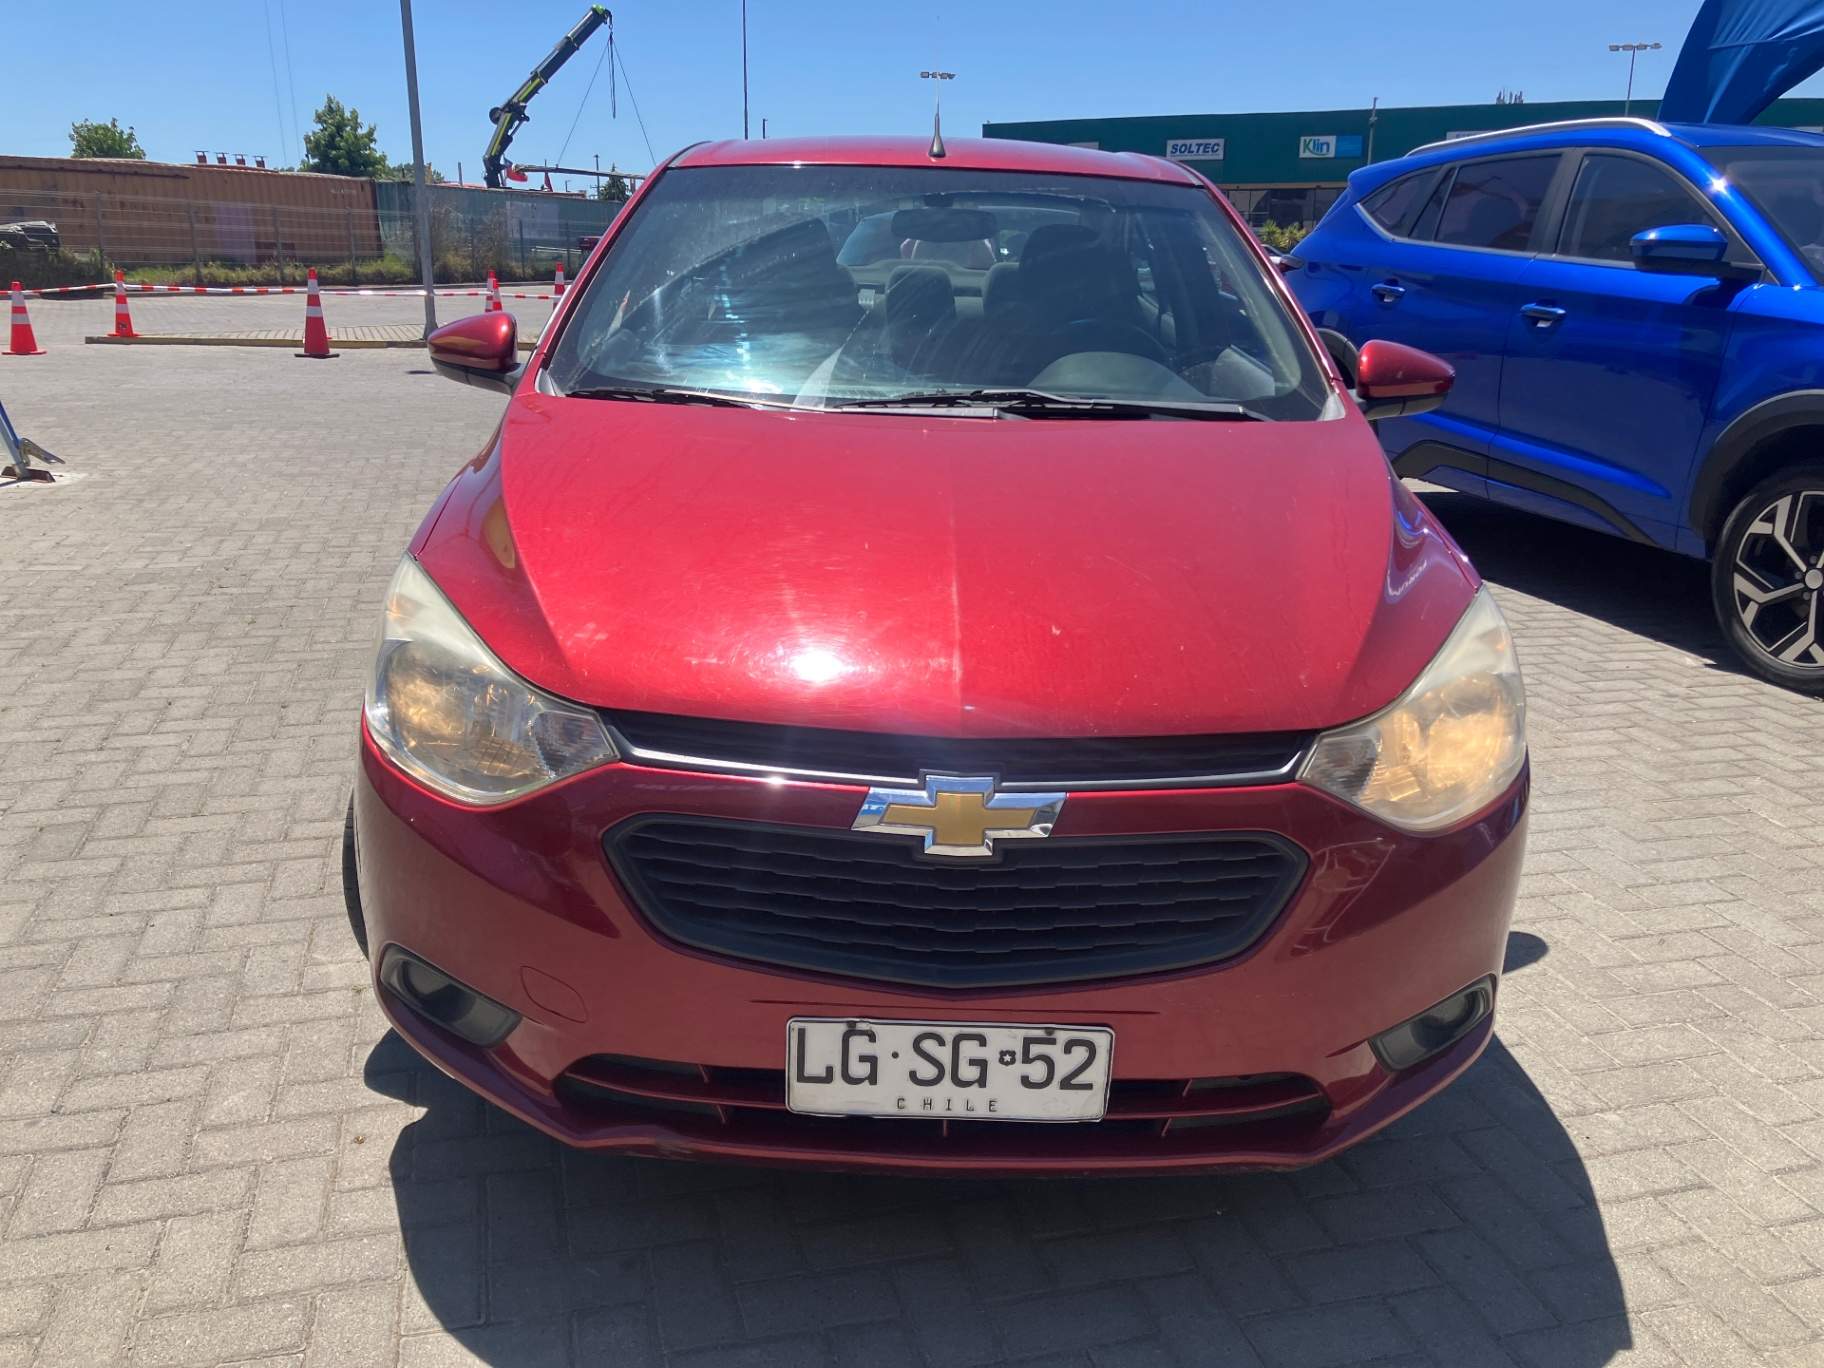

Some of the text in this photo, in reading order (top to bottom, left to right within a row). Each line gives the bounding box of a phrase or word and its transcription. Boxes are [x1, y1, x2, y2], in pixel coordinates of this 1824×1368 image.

[1170, 143, 1221, 154] SOLTEC
[1303, 138, 1330, 156] Klin
[896, 1097, 999, 1113] CHILE
